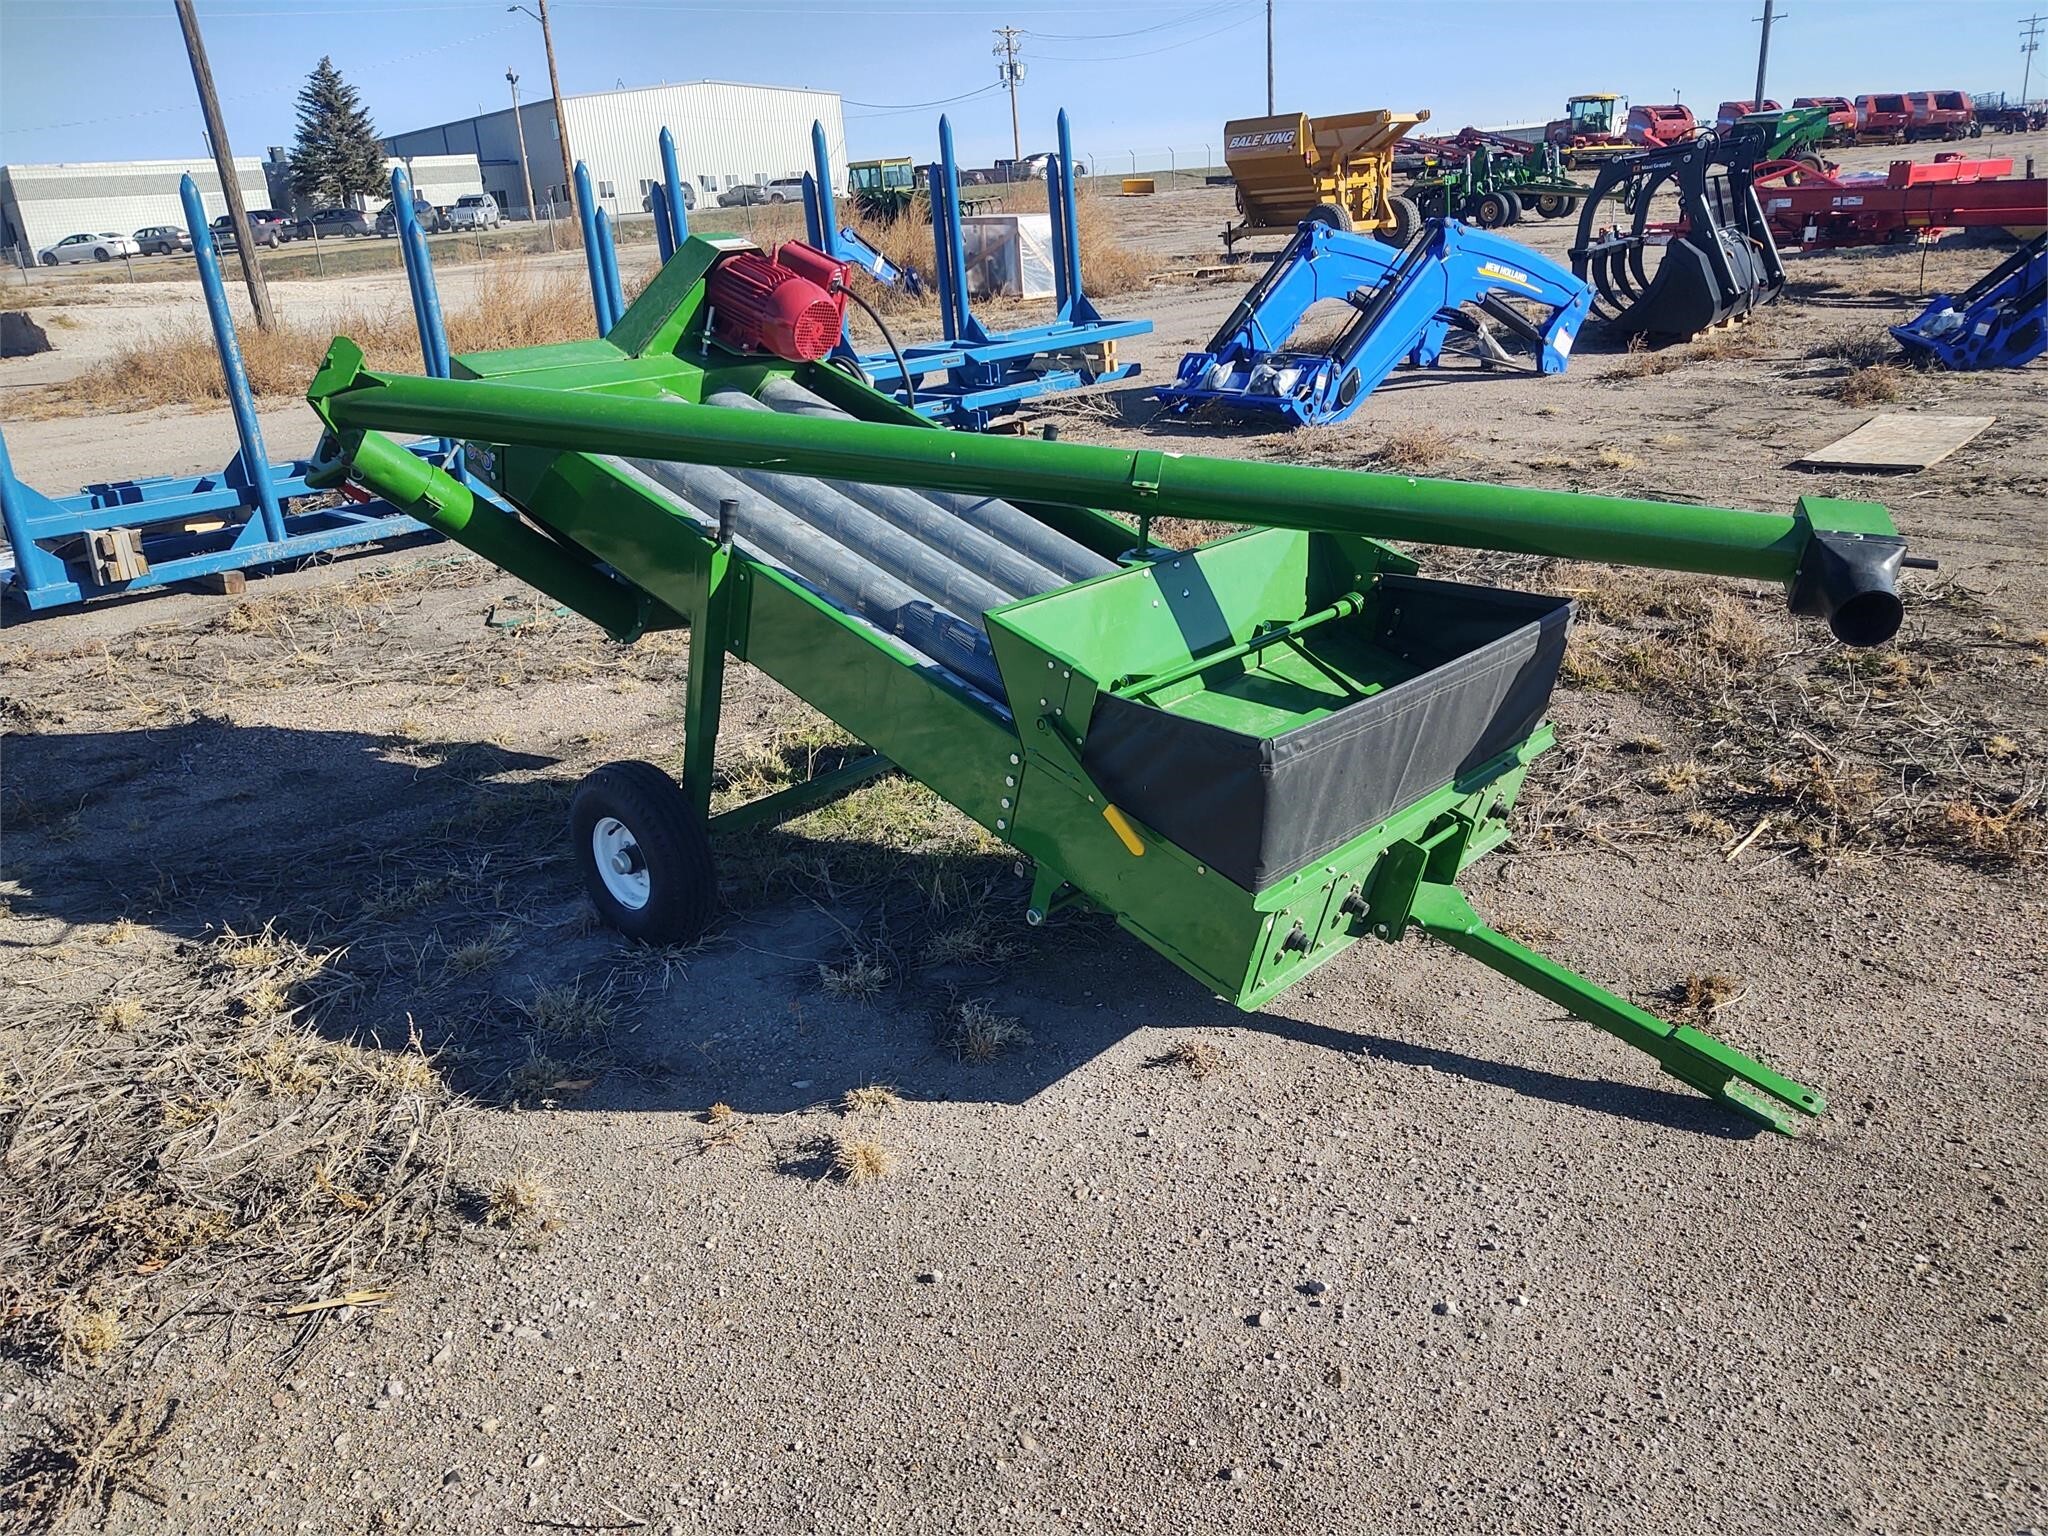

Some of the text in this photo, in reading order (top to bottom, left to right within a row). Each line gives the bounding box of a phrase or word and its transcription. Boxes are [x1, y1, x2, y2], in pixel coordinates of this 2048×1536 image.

[1229, 130, 1296, 149] BALE KING
[1484, 260, 1528, 283] NEW HOLLAND
